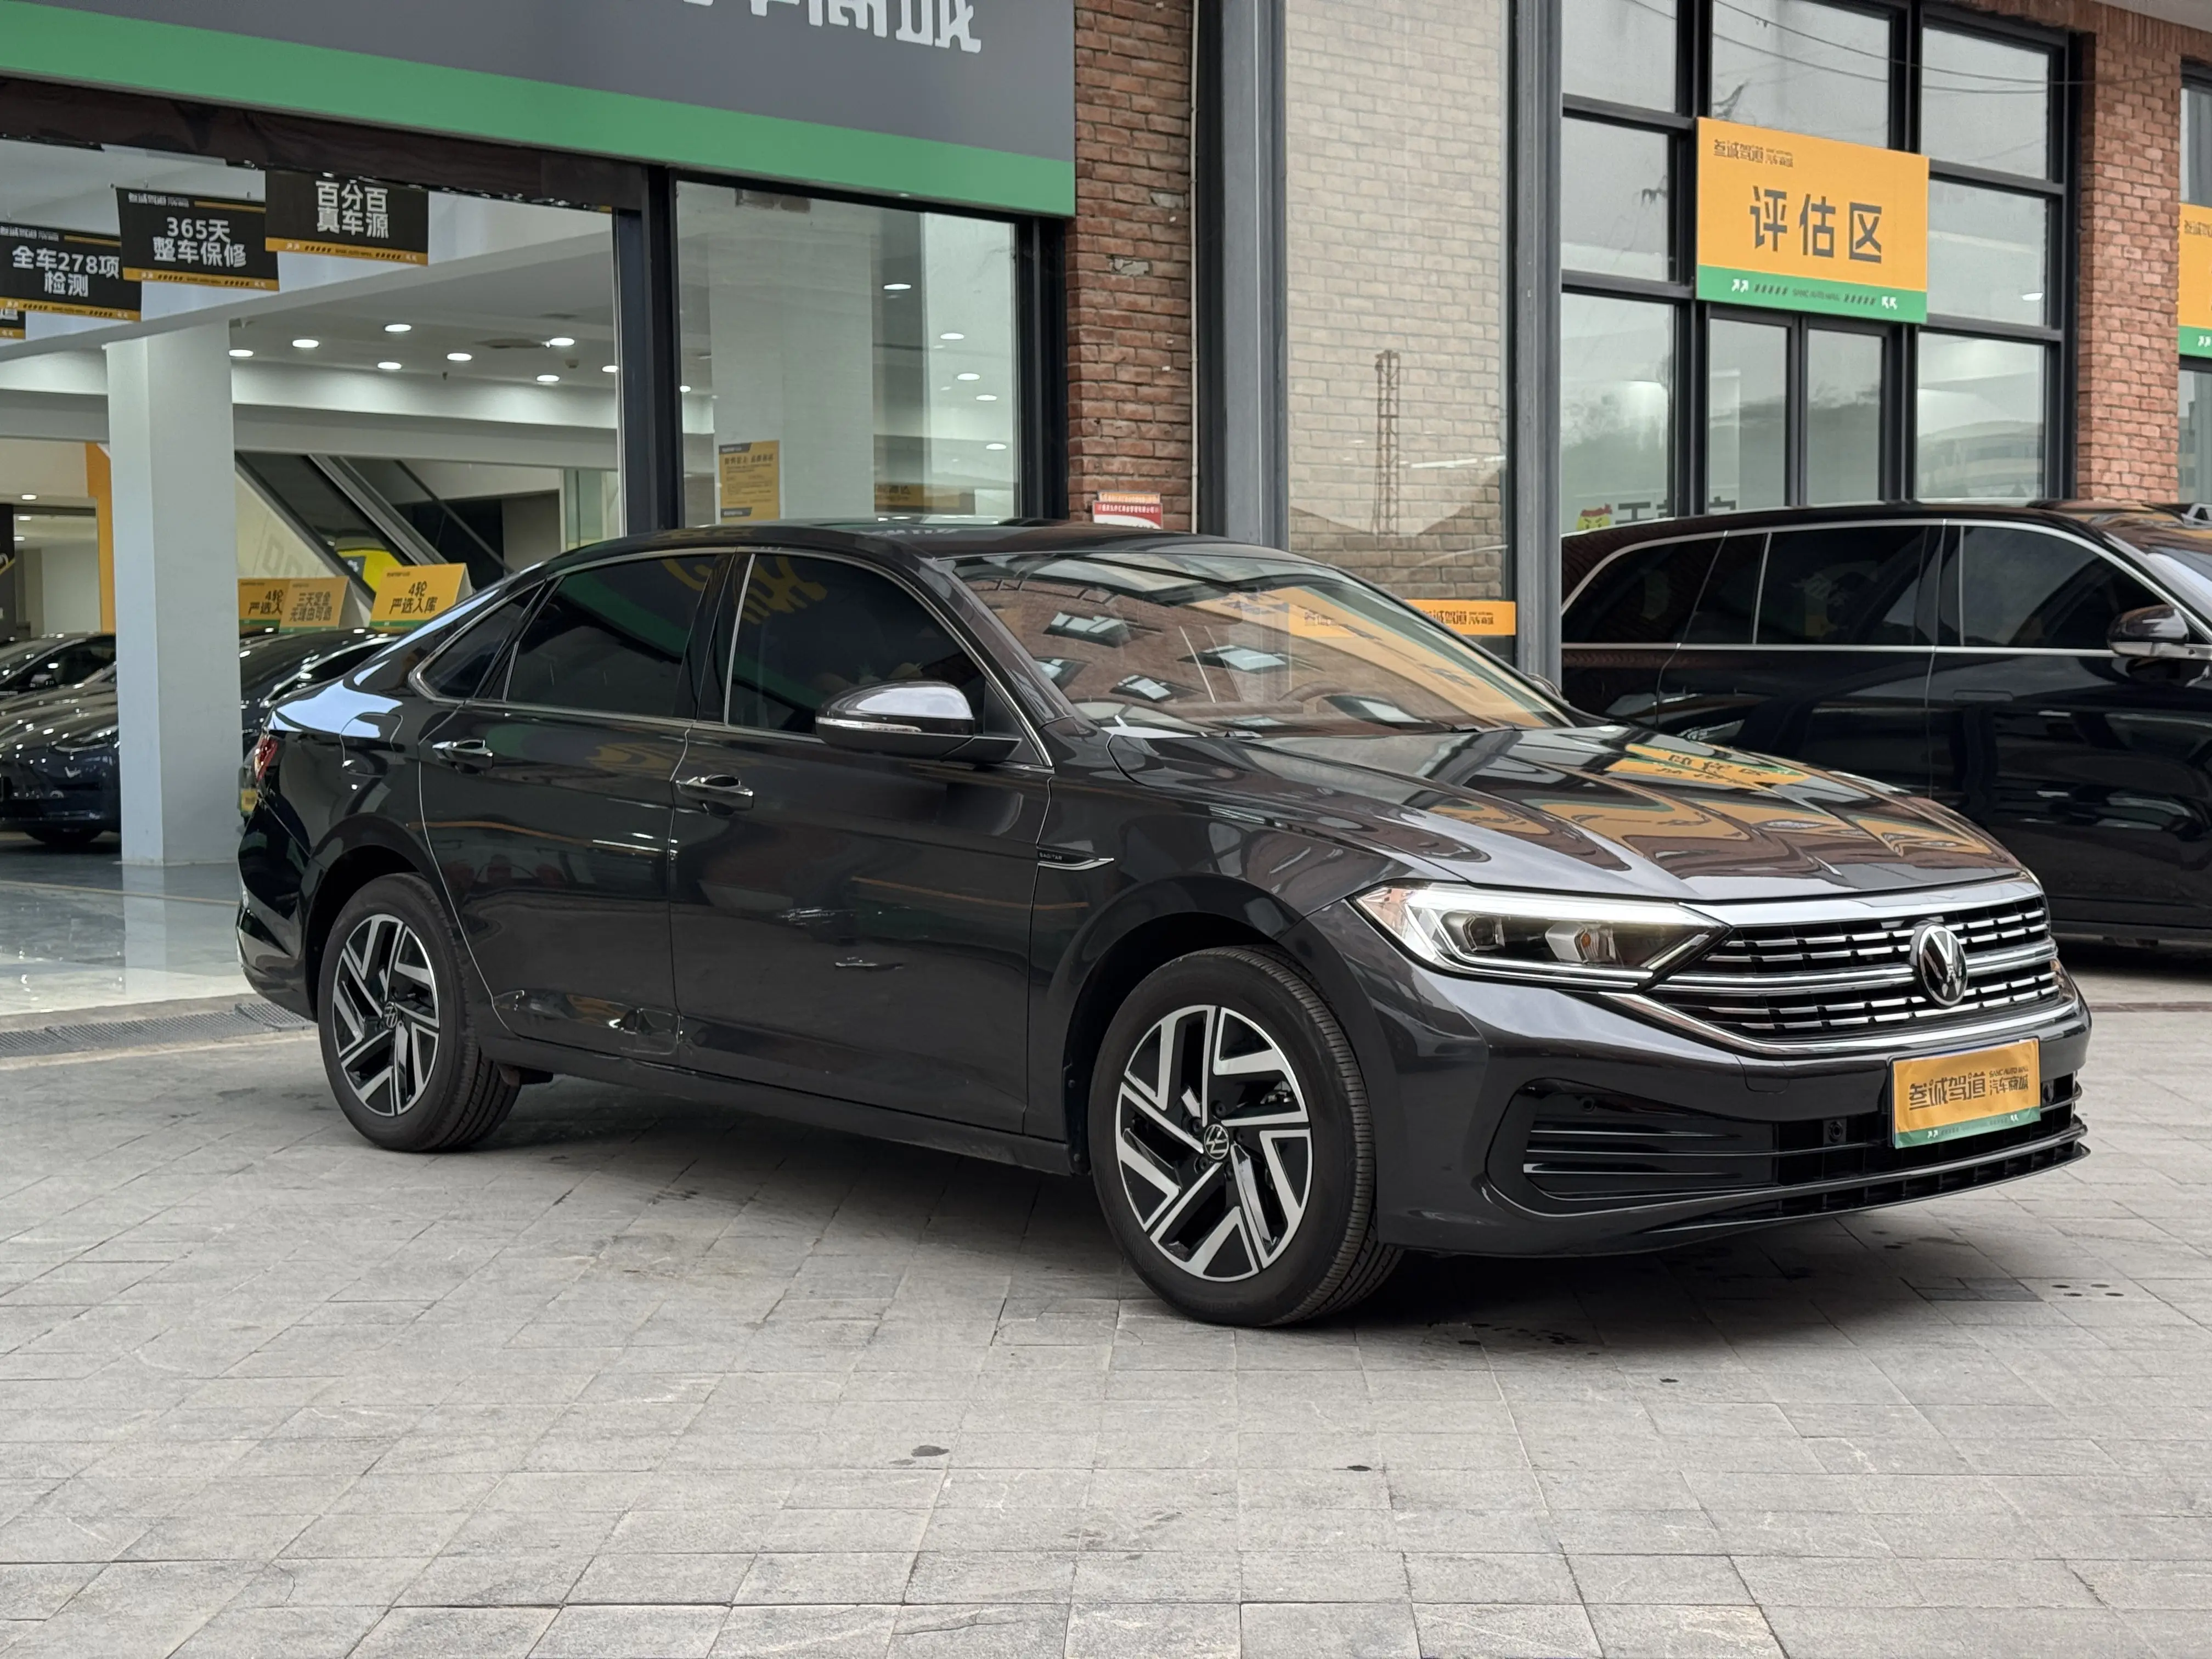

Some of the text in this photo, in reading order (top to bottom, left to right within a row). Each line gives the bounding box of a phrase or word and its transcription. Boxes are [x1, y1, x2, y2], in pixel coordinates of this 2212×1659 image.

[315, 179, 388, 213] 百分百
[166, 216, 230, 244] 365天
[1750, 185, 1882, 264] 评估区
[12, 245, 120, 280] 全车278项
[153, 236, 247, 268] 整车保修
[44, 271, 89, 297] 检测
[1909, 1071, 1985, 1110] 叁诚驾道
